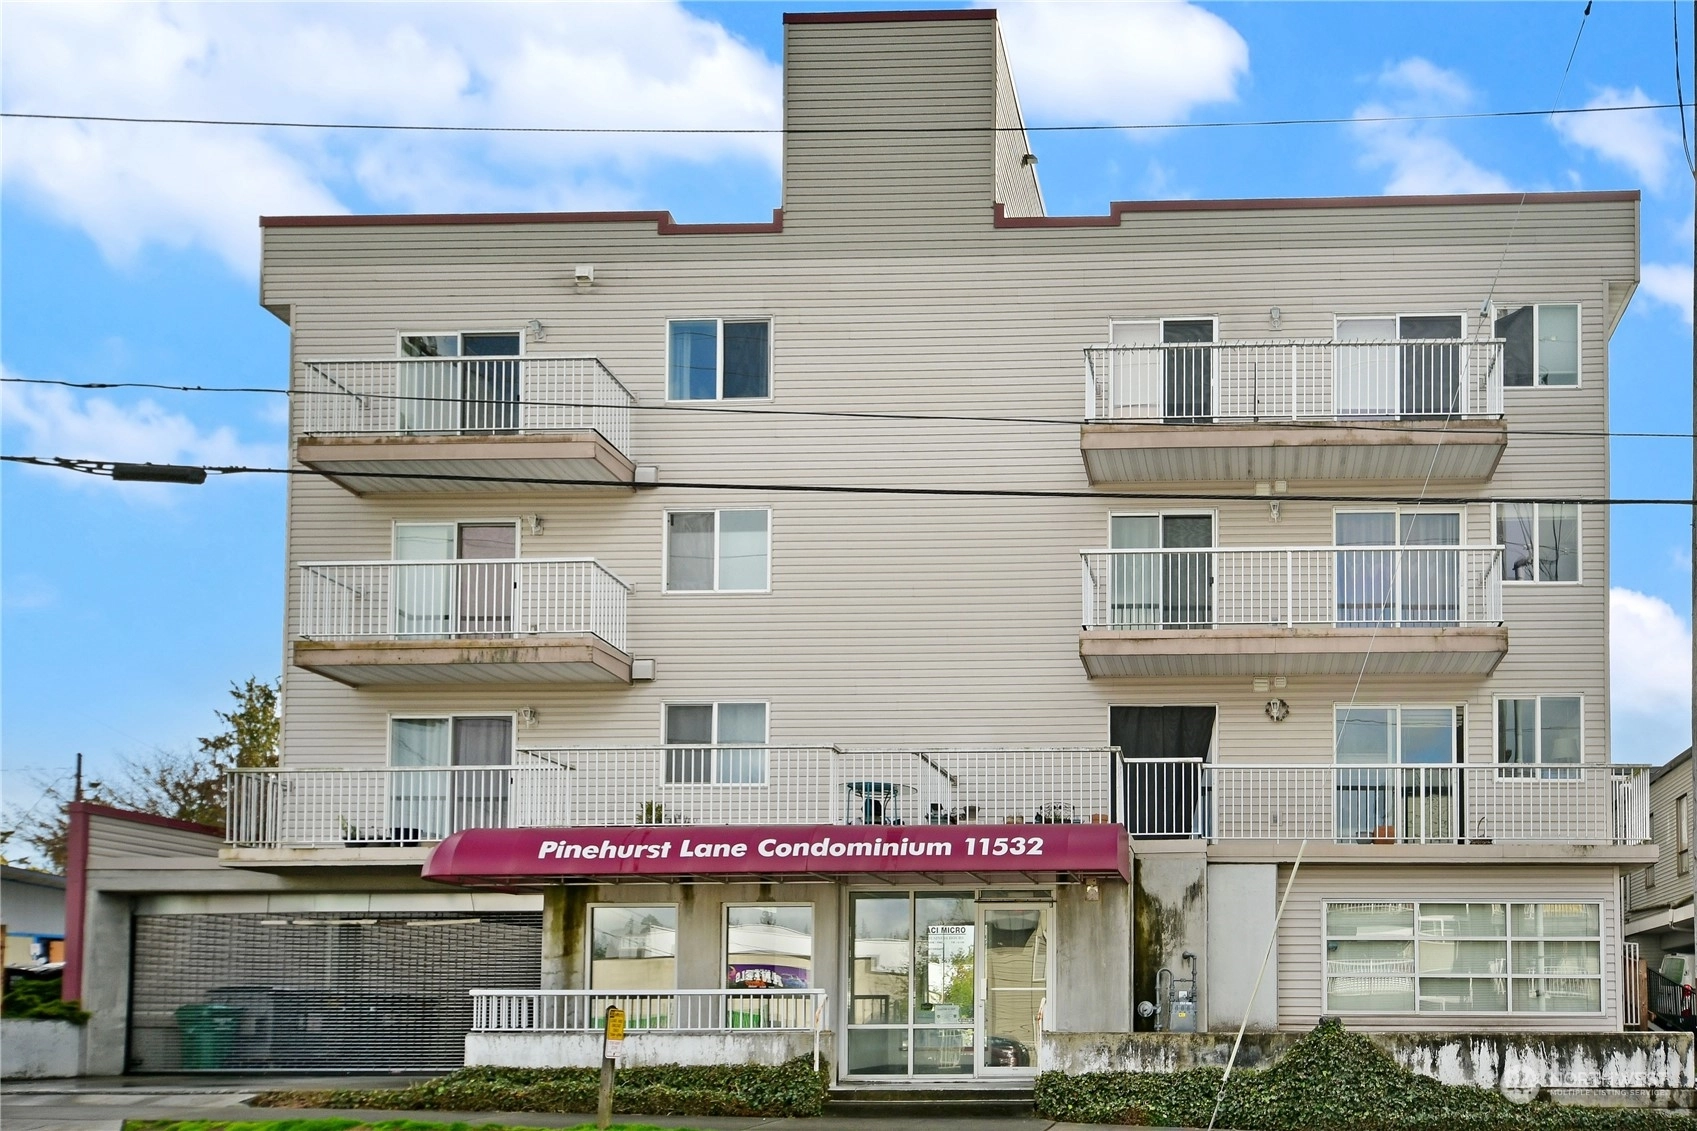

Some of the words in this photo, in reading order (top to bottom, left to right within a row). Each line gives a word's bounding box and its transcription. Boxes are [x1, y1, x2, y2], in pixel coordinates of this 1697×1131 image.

[538, 840, 672, 859] Pinehurst
[679, 839, 748, 858] Lane
[757, 837, 952, 858] Condominium
[964, 837, 1044, 856] 11532
[941, 926, 966, 934] MICRO
